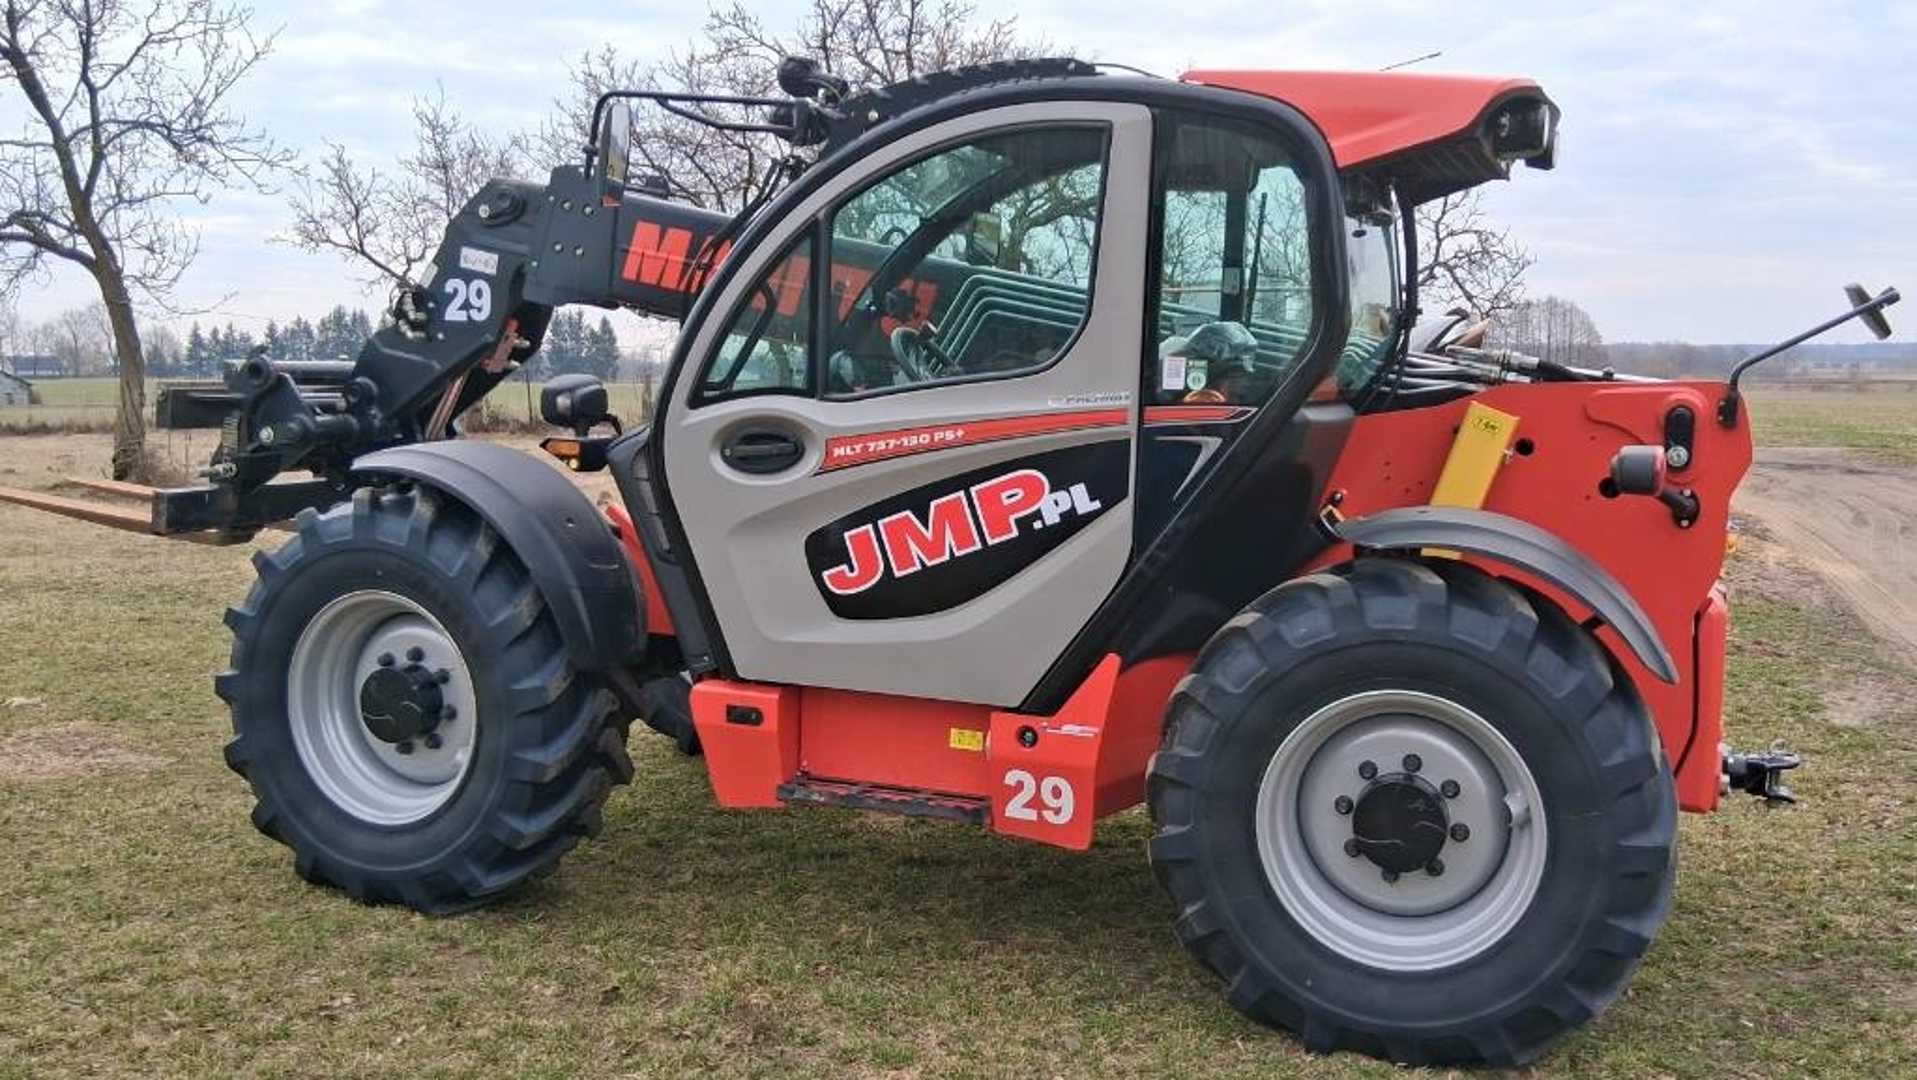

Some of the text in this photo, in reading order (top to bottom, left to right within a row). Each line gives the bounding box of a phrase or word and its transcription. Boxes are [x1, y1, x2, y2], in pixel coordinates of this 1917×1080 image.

[445, 278, 492, 321] 29
[822, 469, 1101, 594] JMP.PL
[1004, 769, 1074, 825] 29
